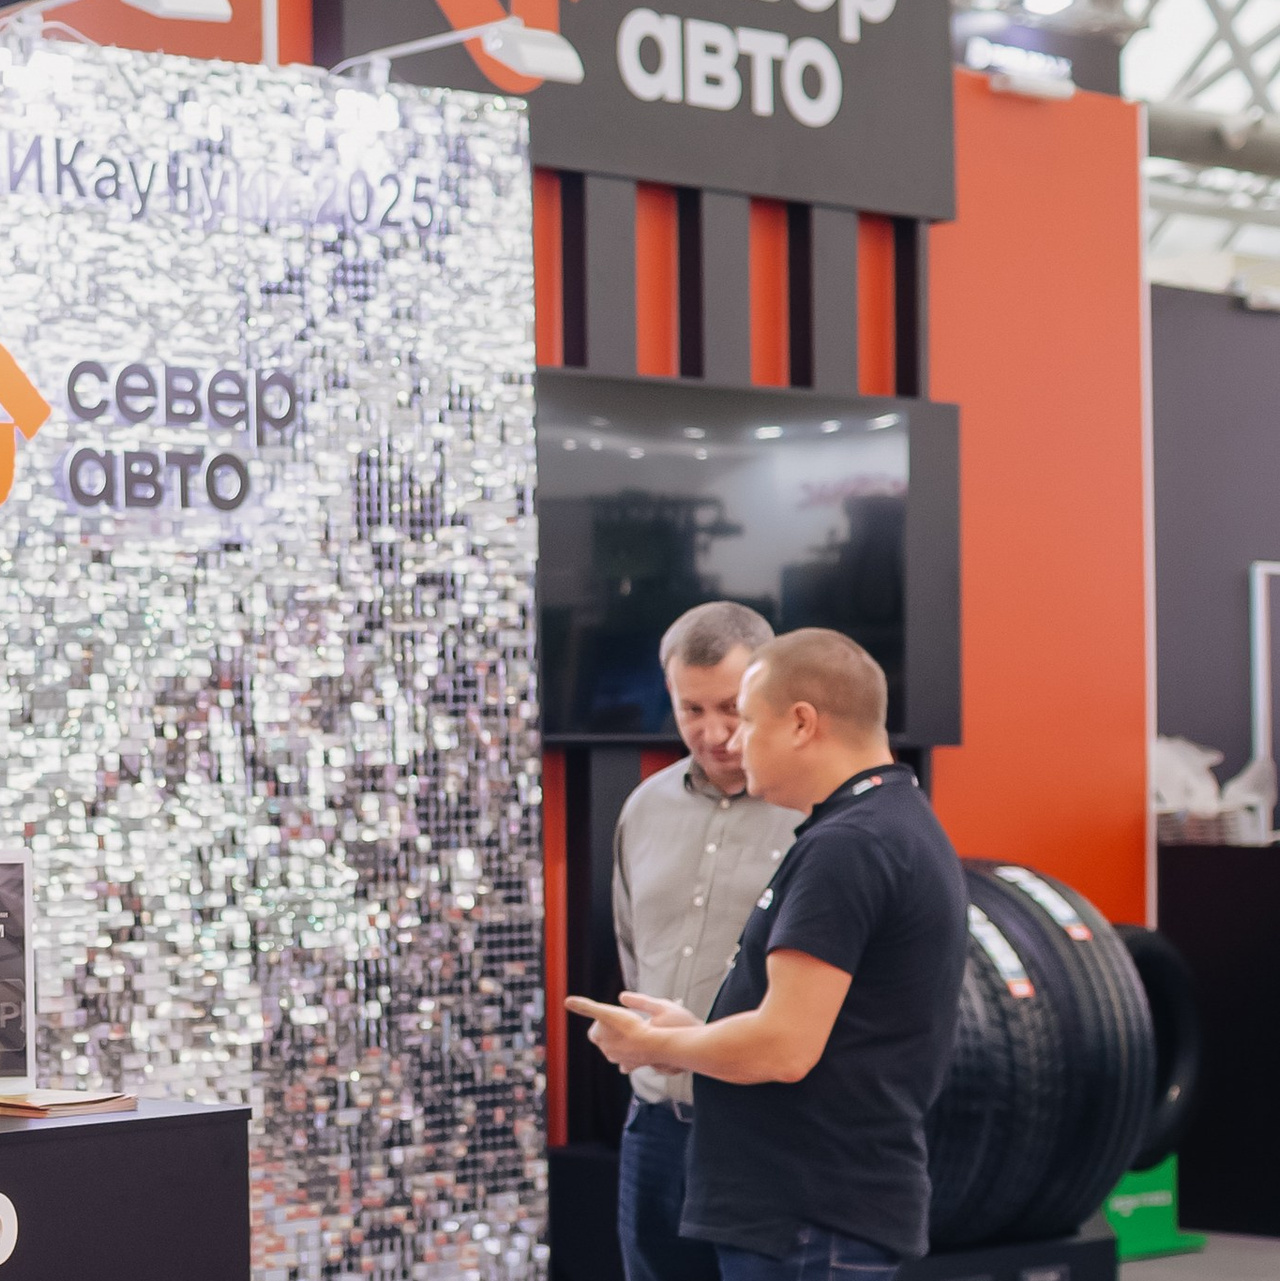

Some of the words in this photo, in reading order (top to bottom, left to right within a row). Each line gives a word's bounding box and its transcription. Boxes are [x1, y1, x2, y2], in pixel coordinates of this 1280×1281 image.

[616, 8, 843, 128] авто
[67, 360, 296, 447] север
[69, 447, 249, 511] авто
